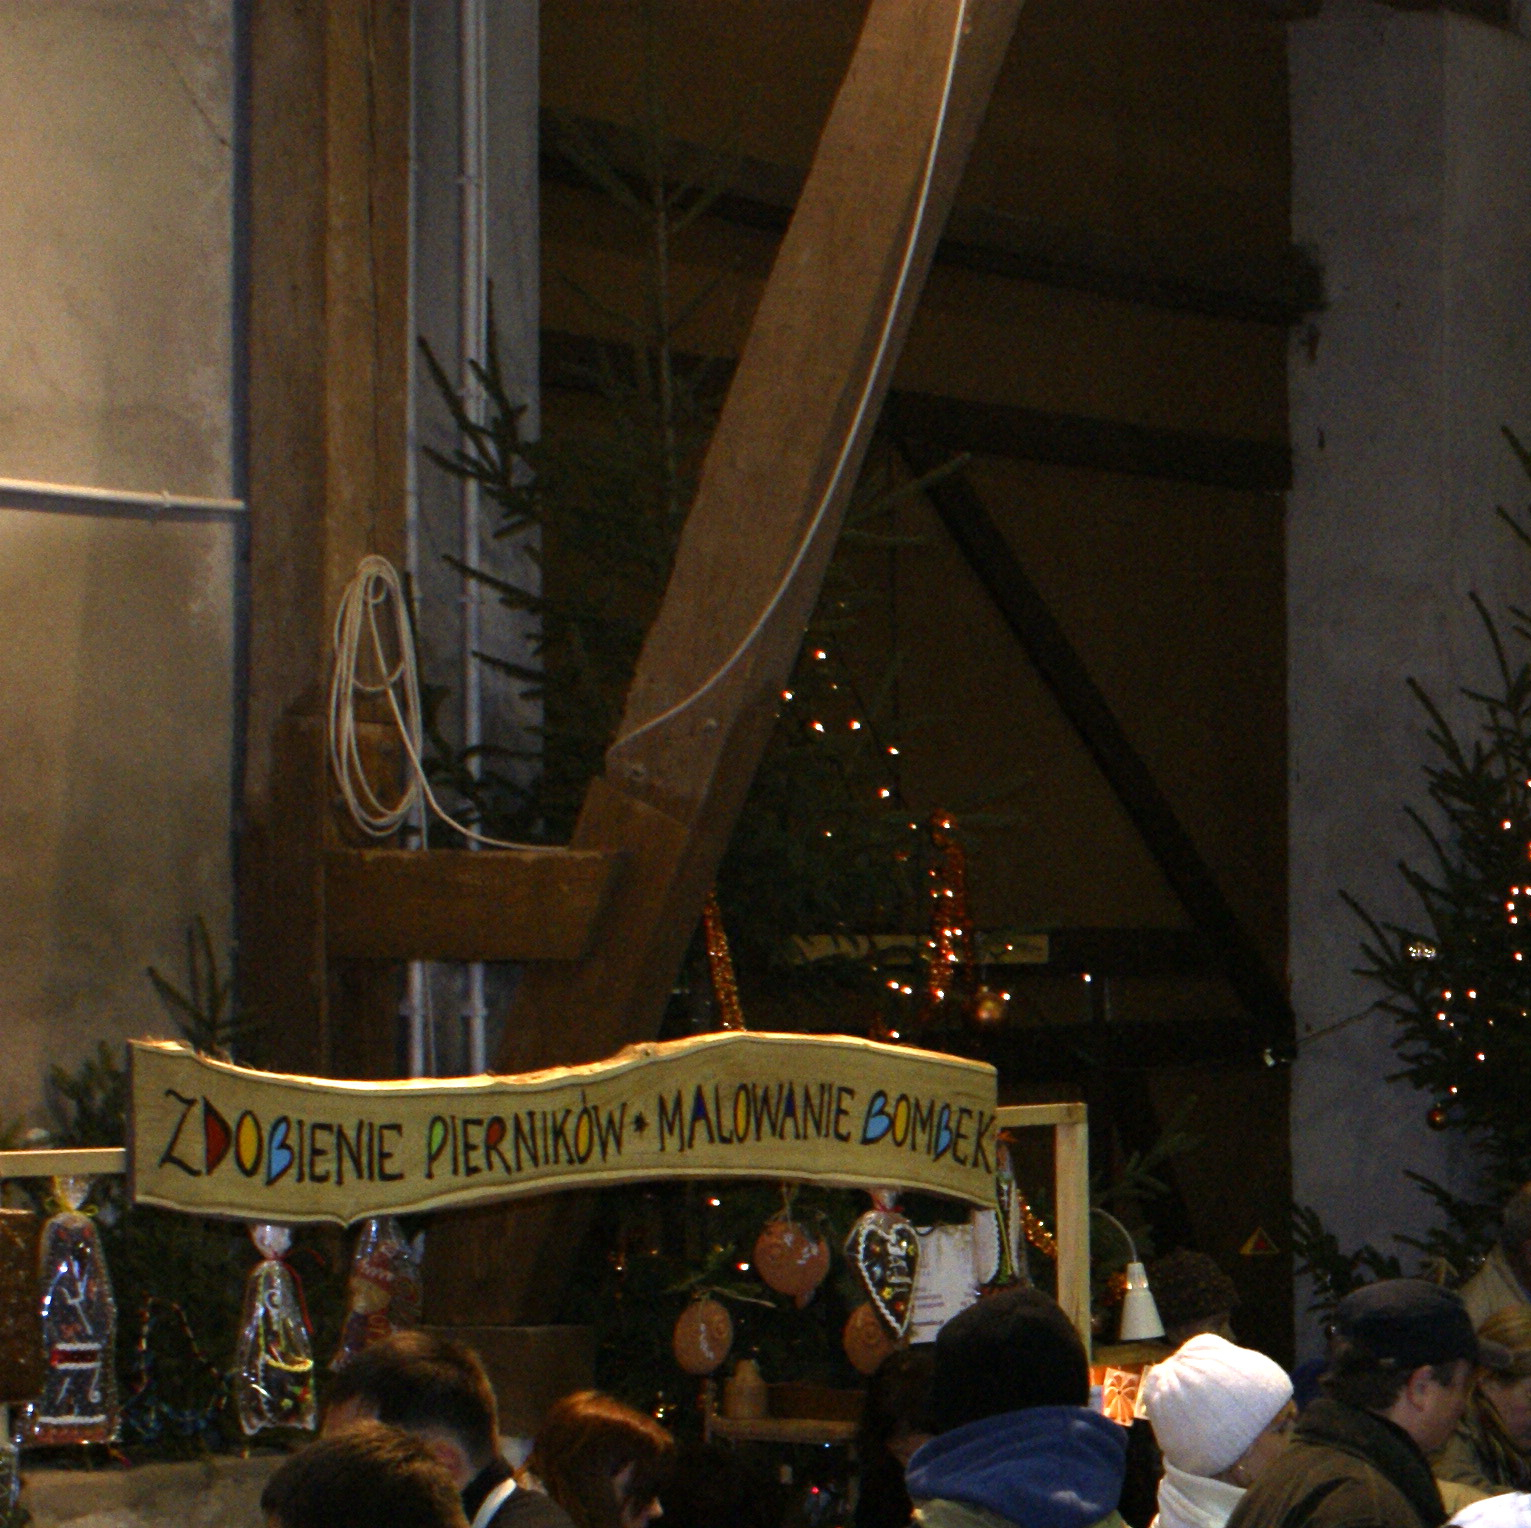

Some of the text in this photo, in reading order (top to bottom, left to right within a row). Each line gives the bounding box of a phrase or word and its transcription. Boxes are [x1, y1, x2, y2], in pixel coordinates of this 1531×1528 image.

[158, 1080, 996, 1186] ZDOBIENIE PIERNIKÓW MALOWANIE BOMBEK
